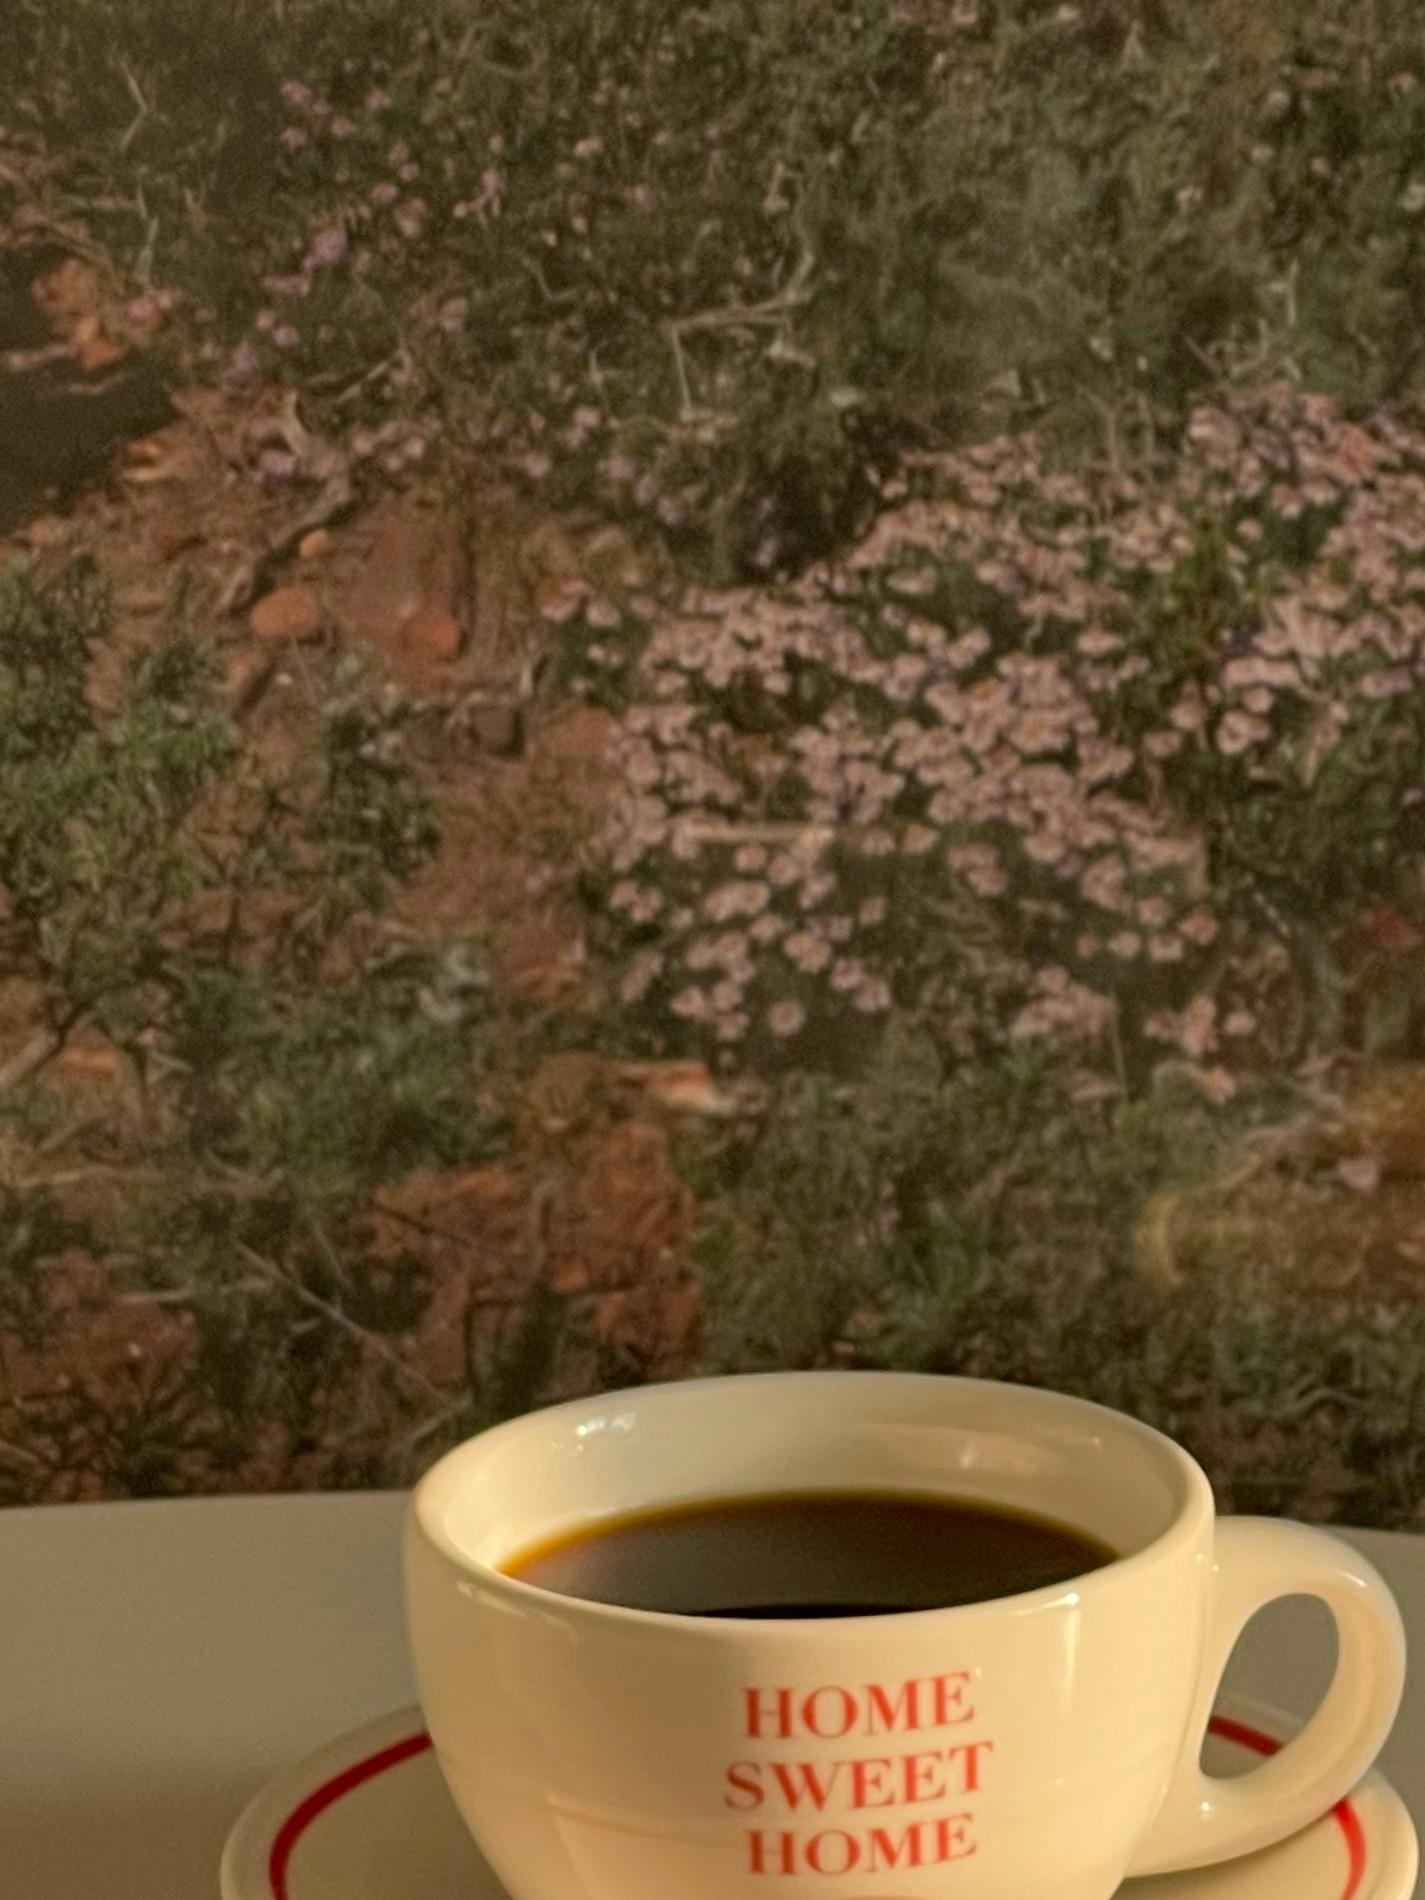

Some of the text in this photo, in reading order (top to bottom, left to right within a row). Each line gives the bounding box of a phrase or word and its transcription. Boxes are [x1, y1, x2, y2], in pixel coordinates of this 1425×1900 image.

[745, 1671, 975, 1737] HOME
[723, 1740, 994, 1812] SWEET
[747, 1813, 977, 1876] HOME
